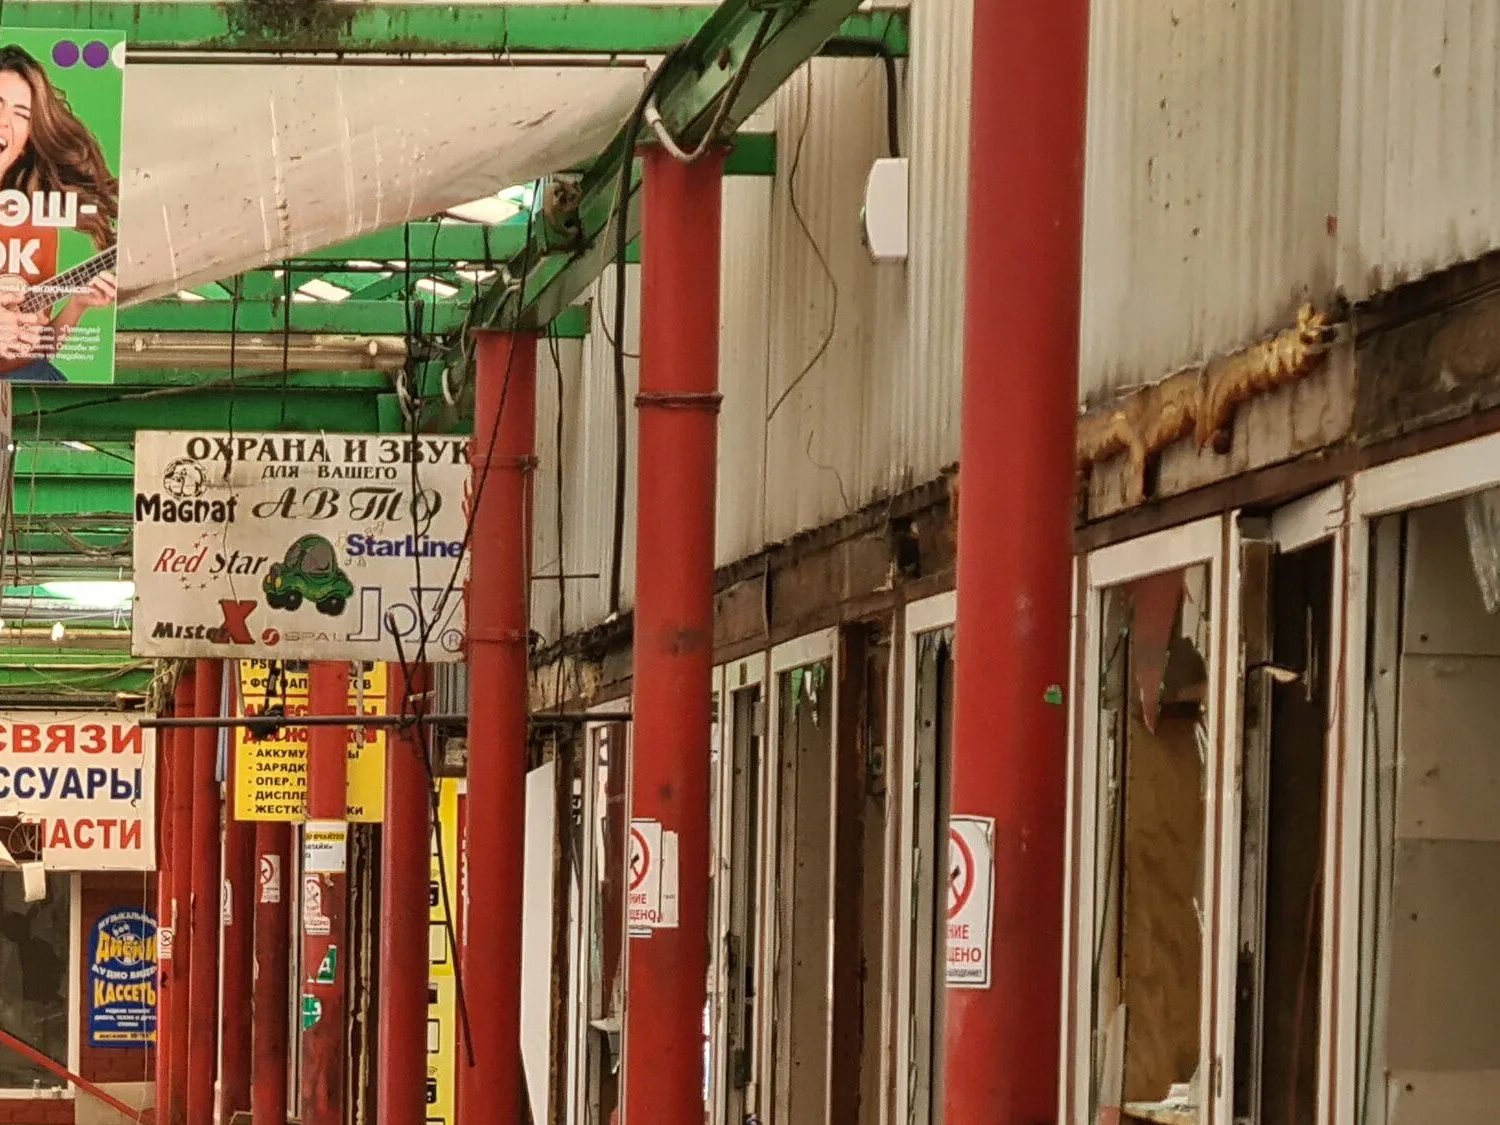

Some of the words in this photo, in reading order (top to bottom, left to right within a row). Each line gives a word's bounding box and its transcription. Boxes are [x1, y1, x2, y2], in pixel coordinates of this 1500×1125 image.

[187, 437, 331, 463] ОХРАНА
[343, 439, 368, 462] И
[378, 439, 470, 464] ЗВУК
[261, 465, 299, 479] ДЛЯ
[317, 466, 397, 479] ВАШЕГО
[346, 533, 465, 558] StarLine
[152, 546, 209, 573] Red
[209, 550, 268, 575] Star
[256, 763, 307, 772] ЗАРЯДК
[255, 791, 307, 800] ДИСПЛЕ
[255, 805, 304, 814] ЖЕСТК
